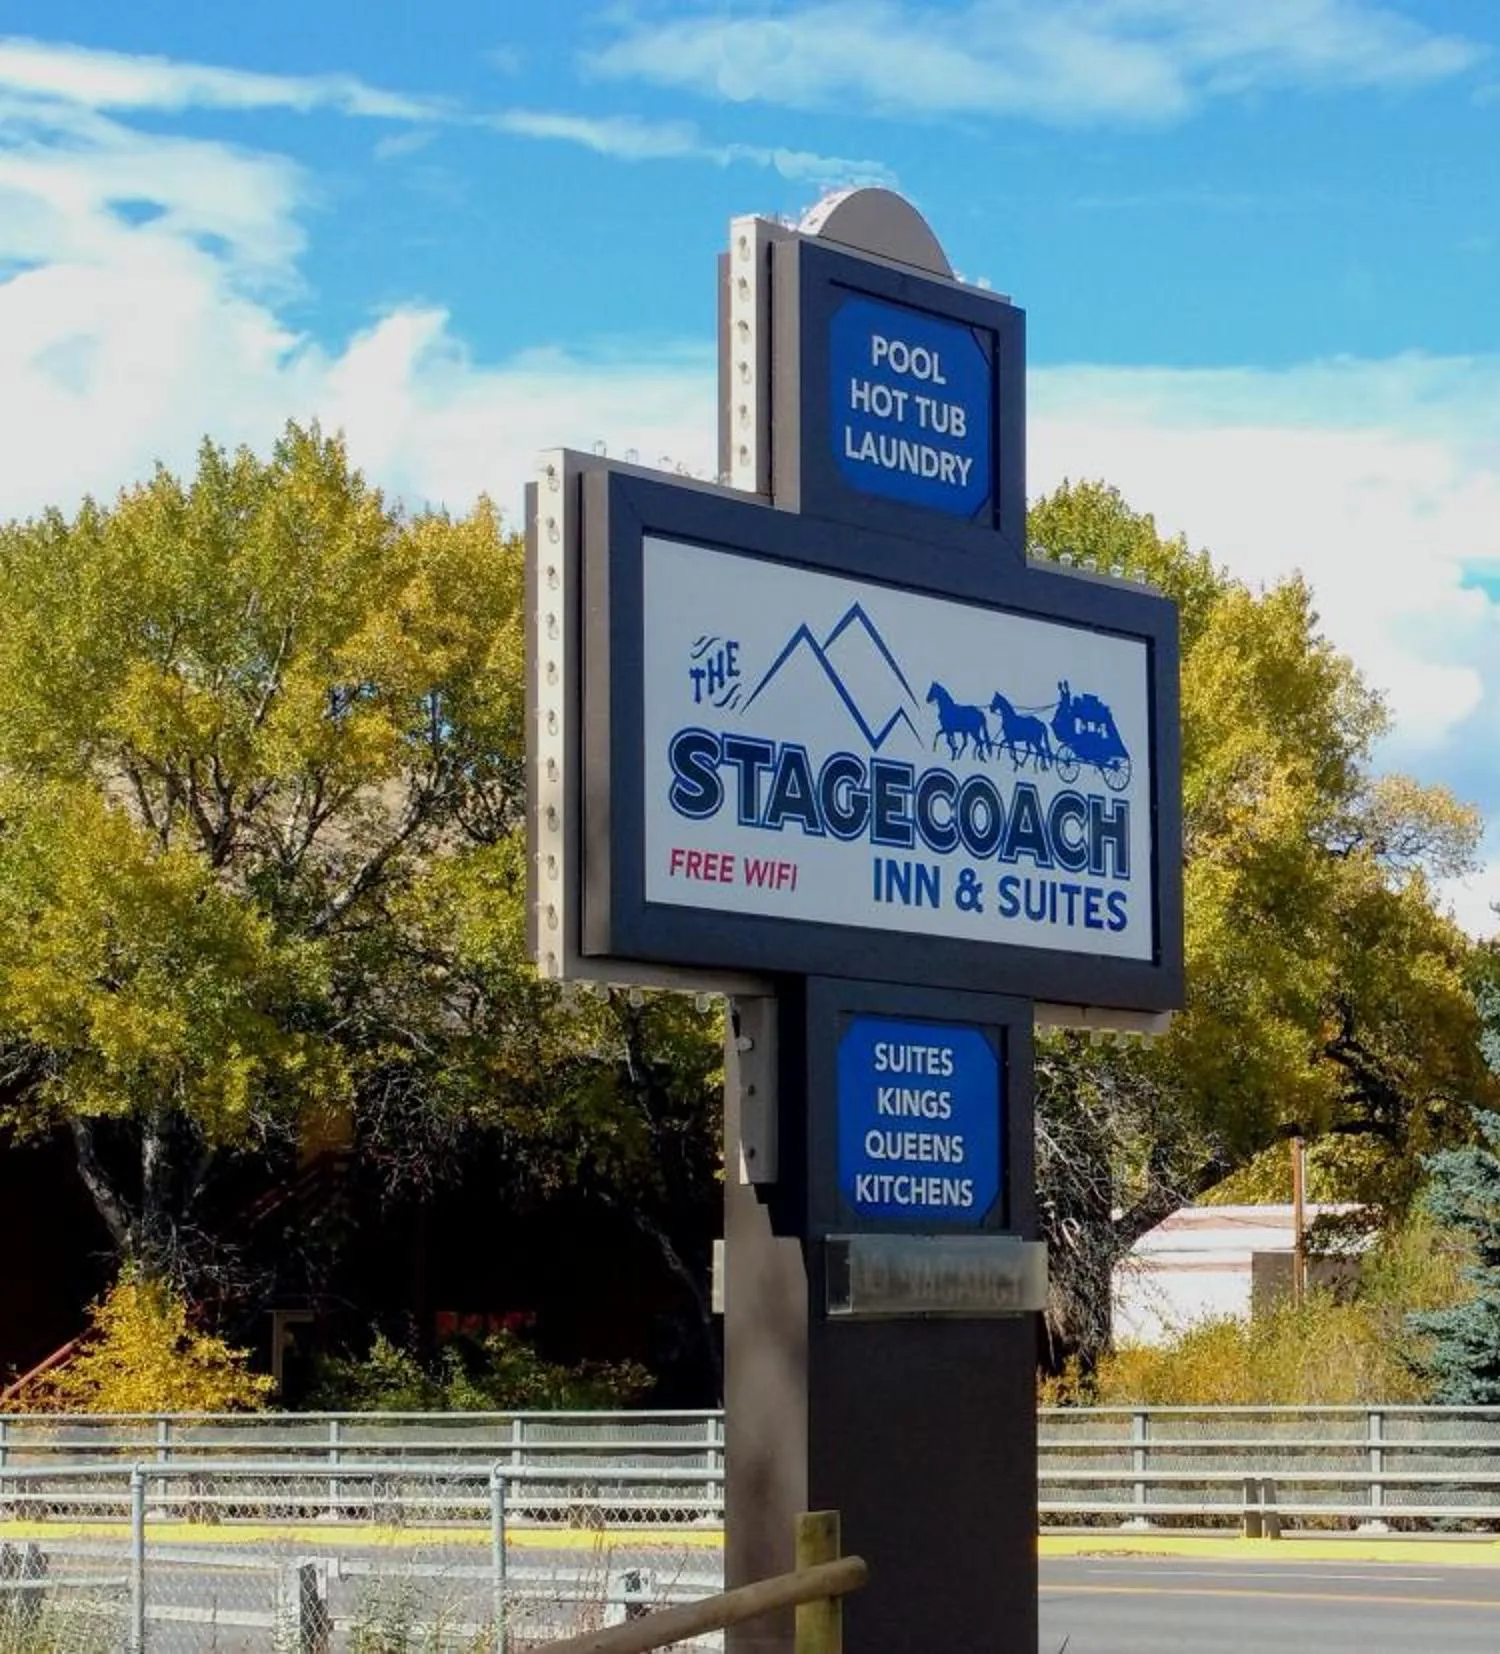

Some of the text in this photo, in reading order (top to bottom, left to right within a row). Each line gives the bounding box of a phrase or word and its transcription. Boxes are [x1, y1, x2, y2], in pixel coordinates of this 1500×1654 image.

[871, 335, 947, 385] POOL
[850, 378, 967, 437] HOT TUB
[845, 425, 973, 487] LAUNDRY
[689, 640, 740, 704] THE
[668, 727, 1132, 880] STAGECOACH
[669, 848, 798, 892] FREE WIFI
[873, 858, 1128, 933] INN & SUITES
[874, 1043, 954, 1077] SUITES
[877, 1087, 951, 1119] KINGS
[865, 1130, 964, 1163] QUEENS
[855, 1174, 973, 1207] KITCHENS
